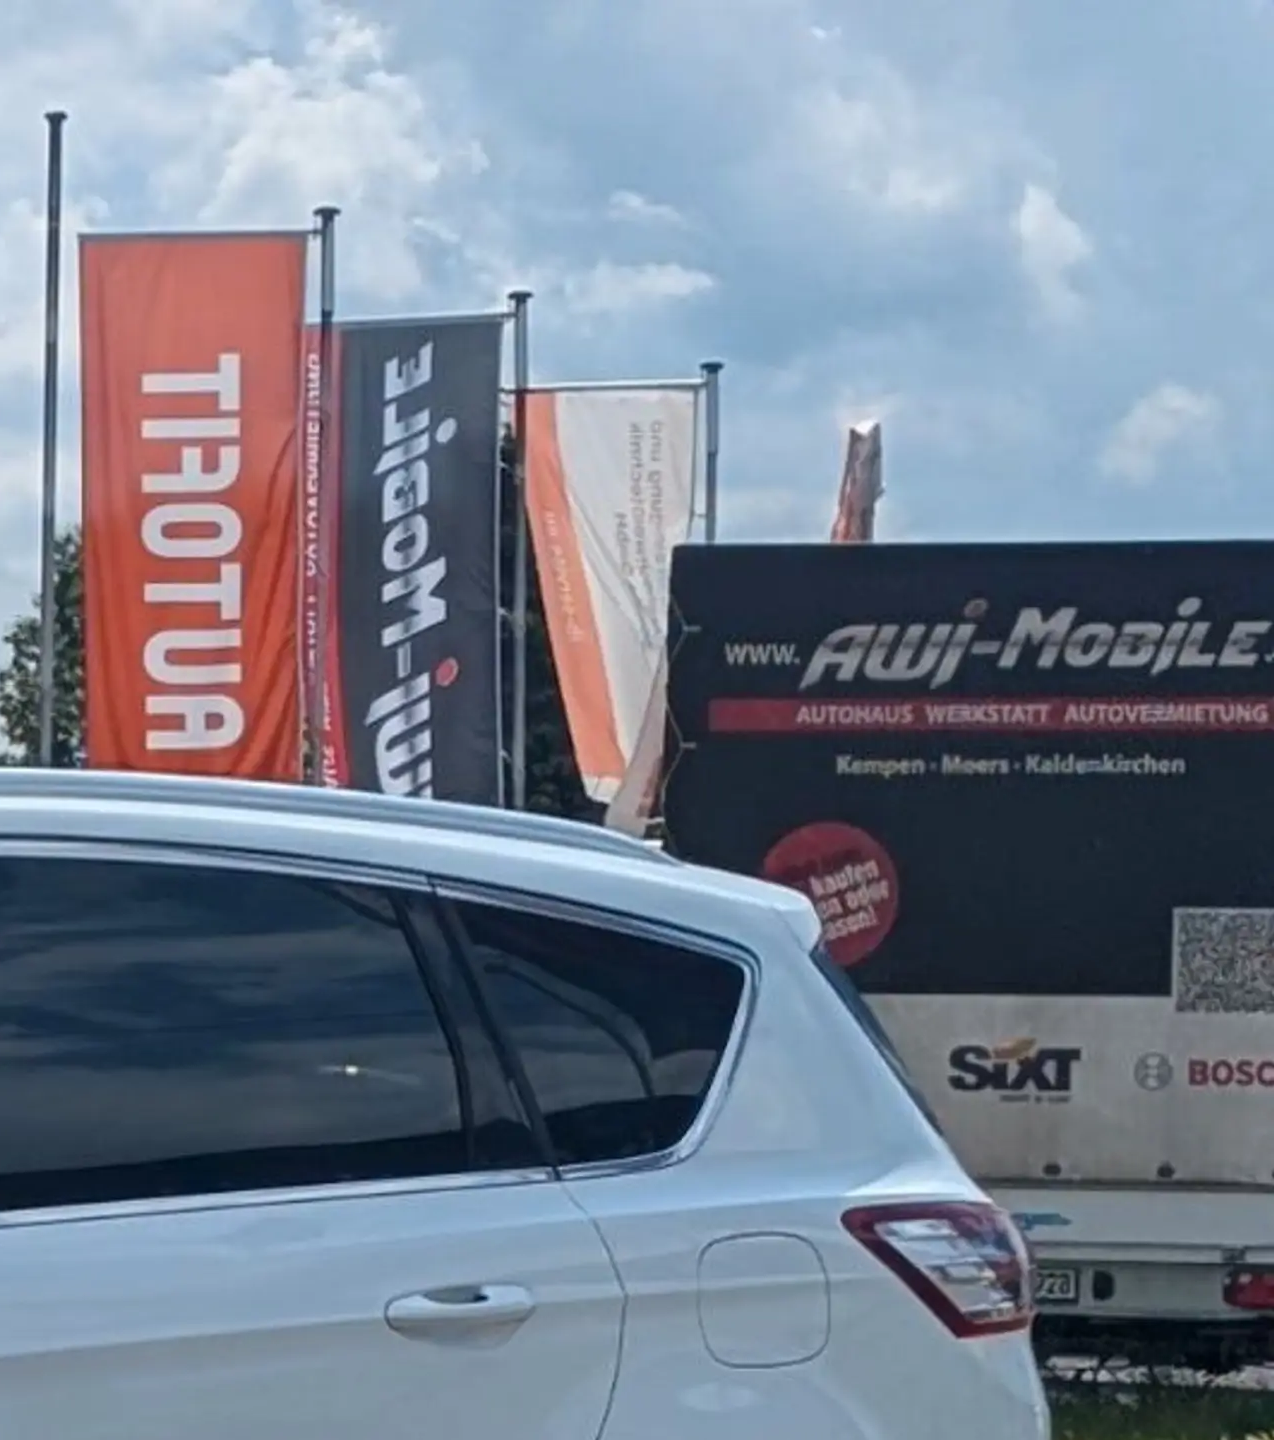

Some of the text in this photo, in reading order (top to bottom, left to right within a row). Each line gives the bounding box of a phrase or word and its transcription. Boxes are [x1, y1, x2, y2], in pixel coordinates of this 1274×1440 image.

[796, 704, 1269, 724] AUTOHAUS WERKSTATT AUTOVERMIETUNG
[836, 754, 1186, 777] Kempen Moers Kaldenkirchen
